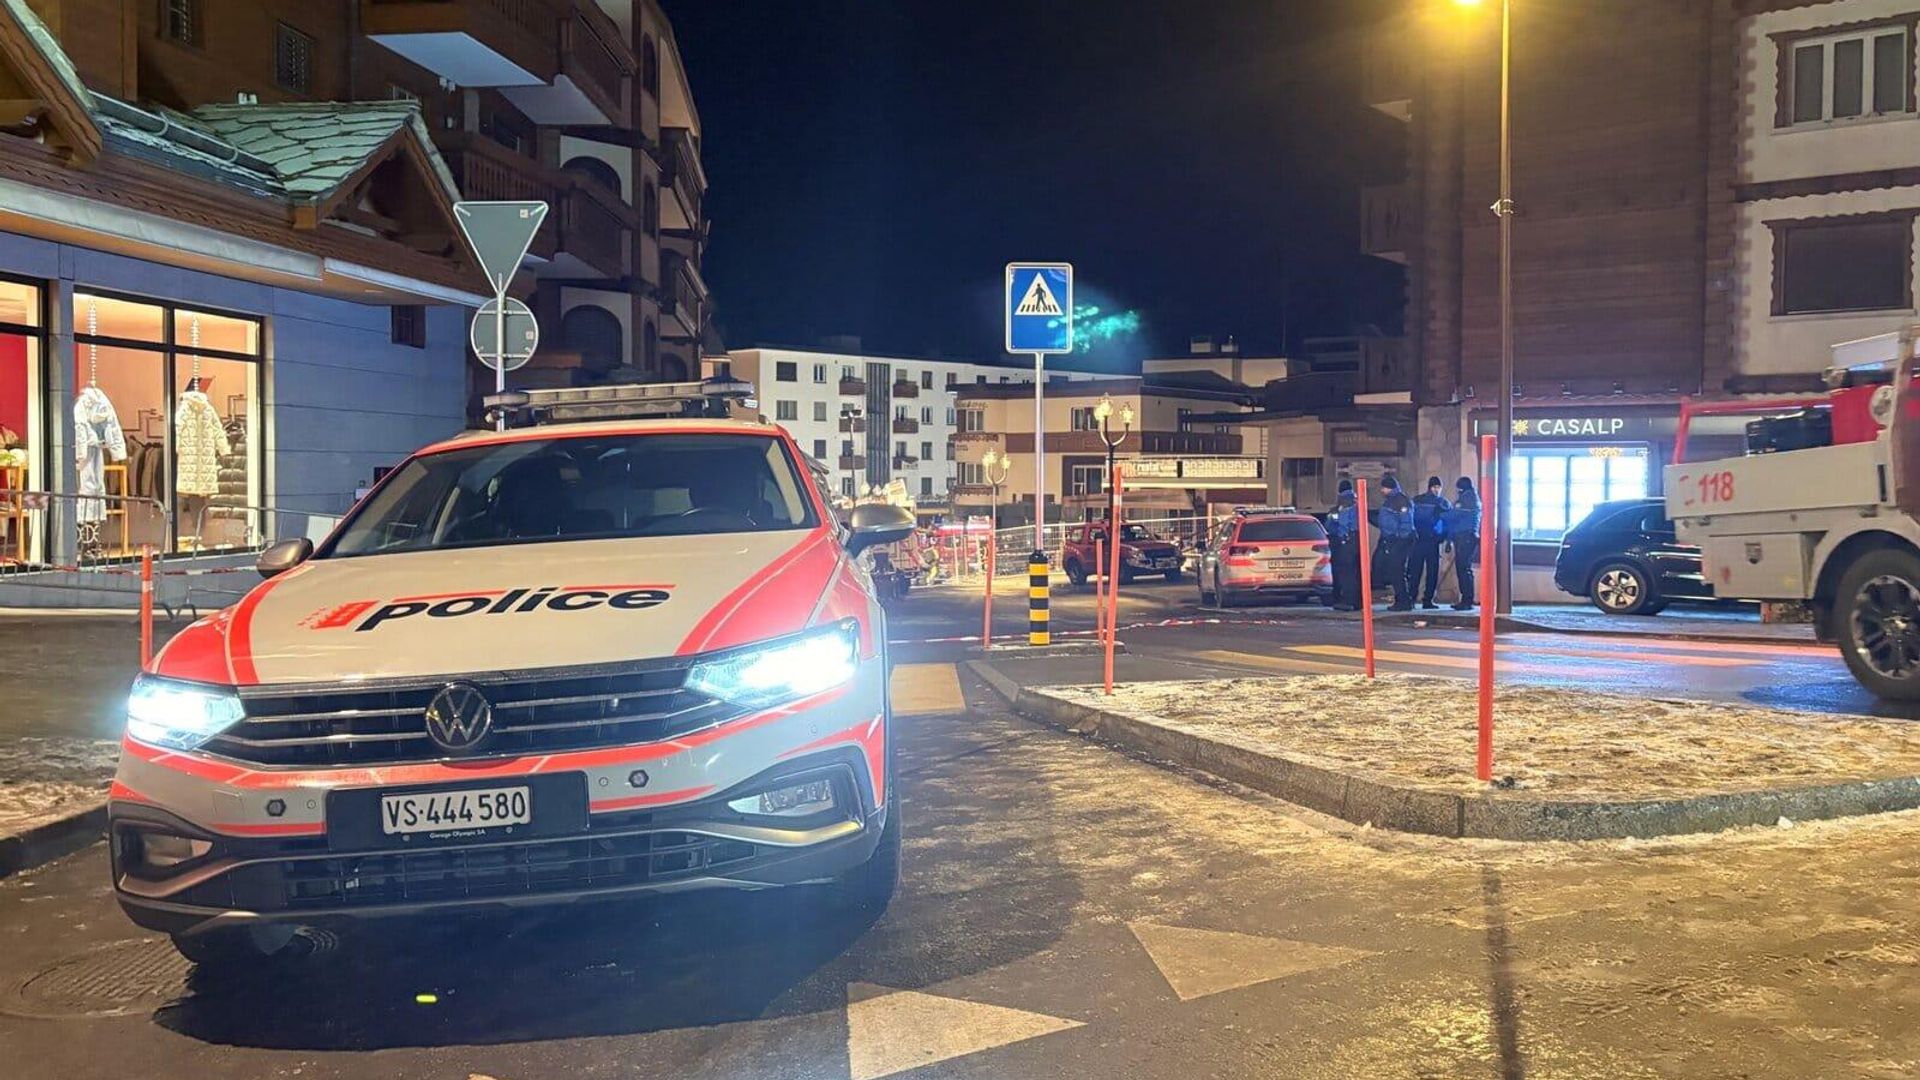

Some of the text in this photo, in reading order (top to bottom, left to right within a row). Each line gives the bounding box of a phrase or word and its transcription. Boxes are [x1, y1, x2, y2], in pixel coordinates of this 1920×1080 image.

[1537, 418, 1624, 435] CASALP
[1698, 471, 1734, 502] 118
[354, 586, 671, 632] police
